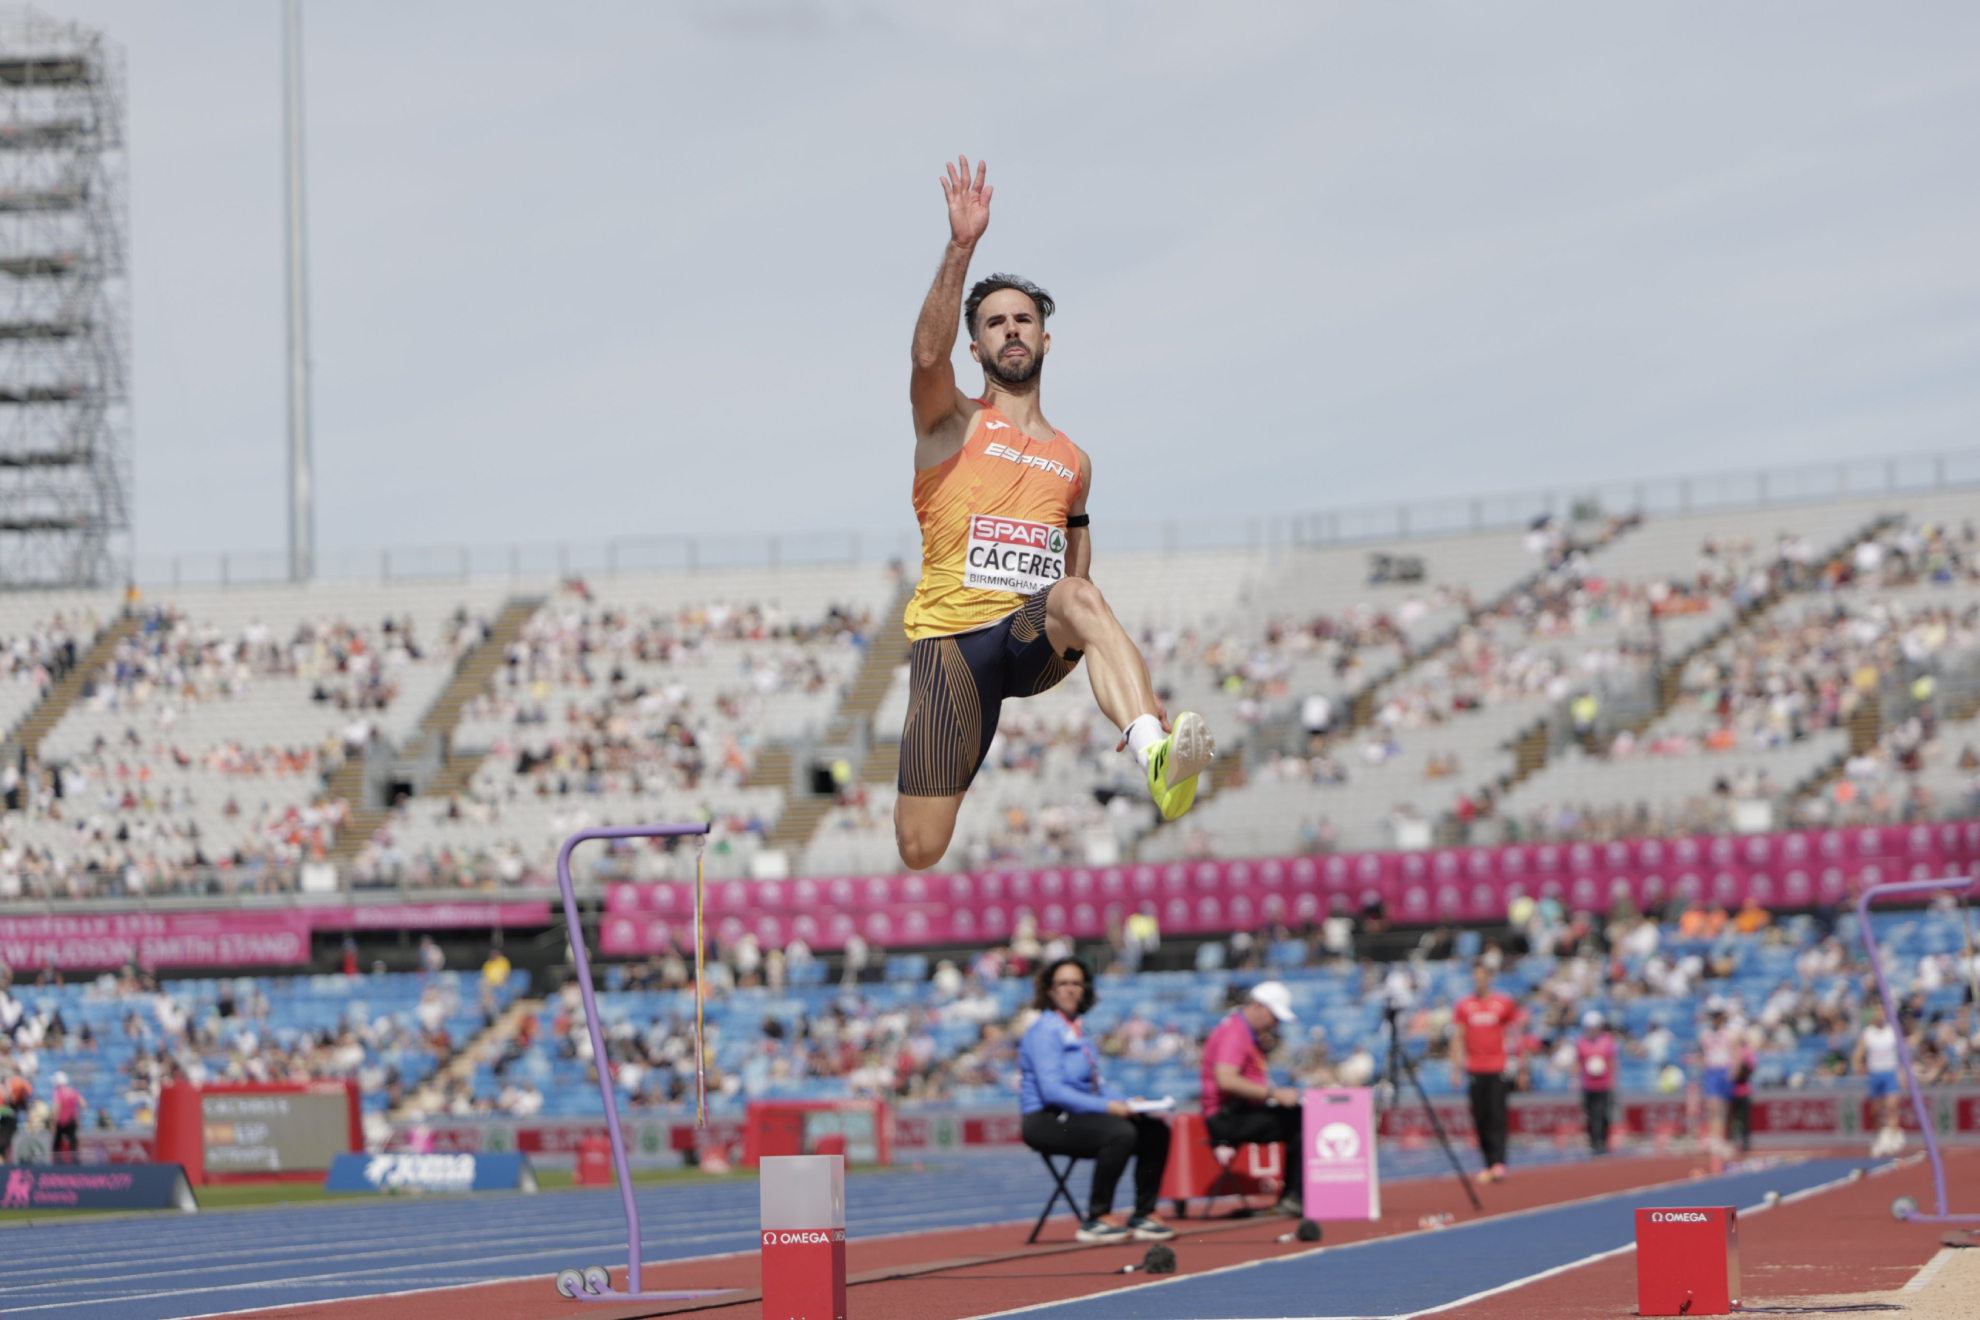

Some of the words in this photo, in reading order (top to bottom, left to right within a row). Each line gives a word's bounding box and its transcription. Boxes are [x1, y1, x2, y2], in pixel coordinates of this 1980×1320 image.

[983, 442, 1075, 483] ESPAÑA
[975, 520, 1047, 546] SPAR
[969, 543, 1062, 580] CÁCERES
[969, 573, 1038, 591] BIRMINGHAM
[1665, 1212, 1708, 1222] OMEGA
[780, 1232, 830, 1244] OMEGA
